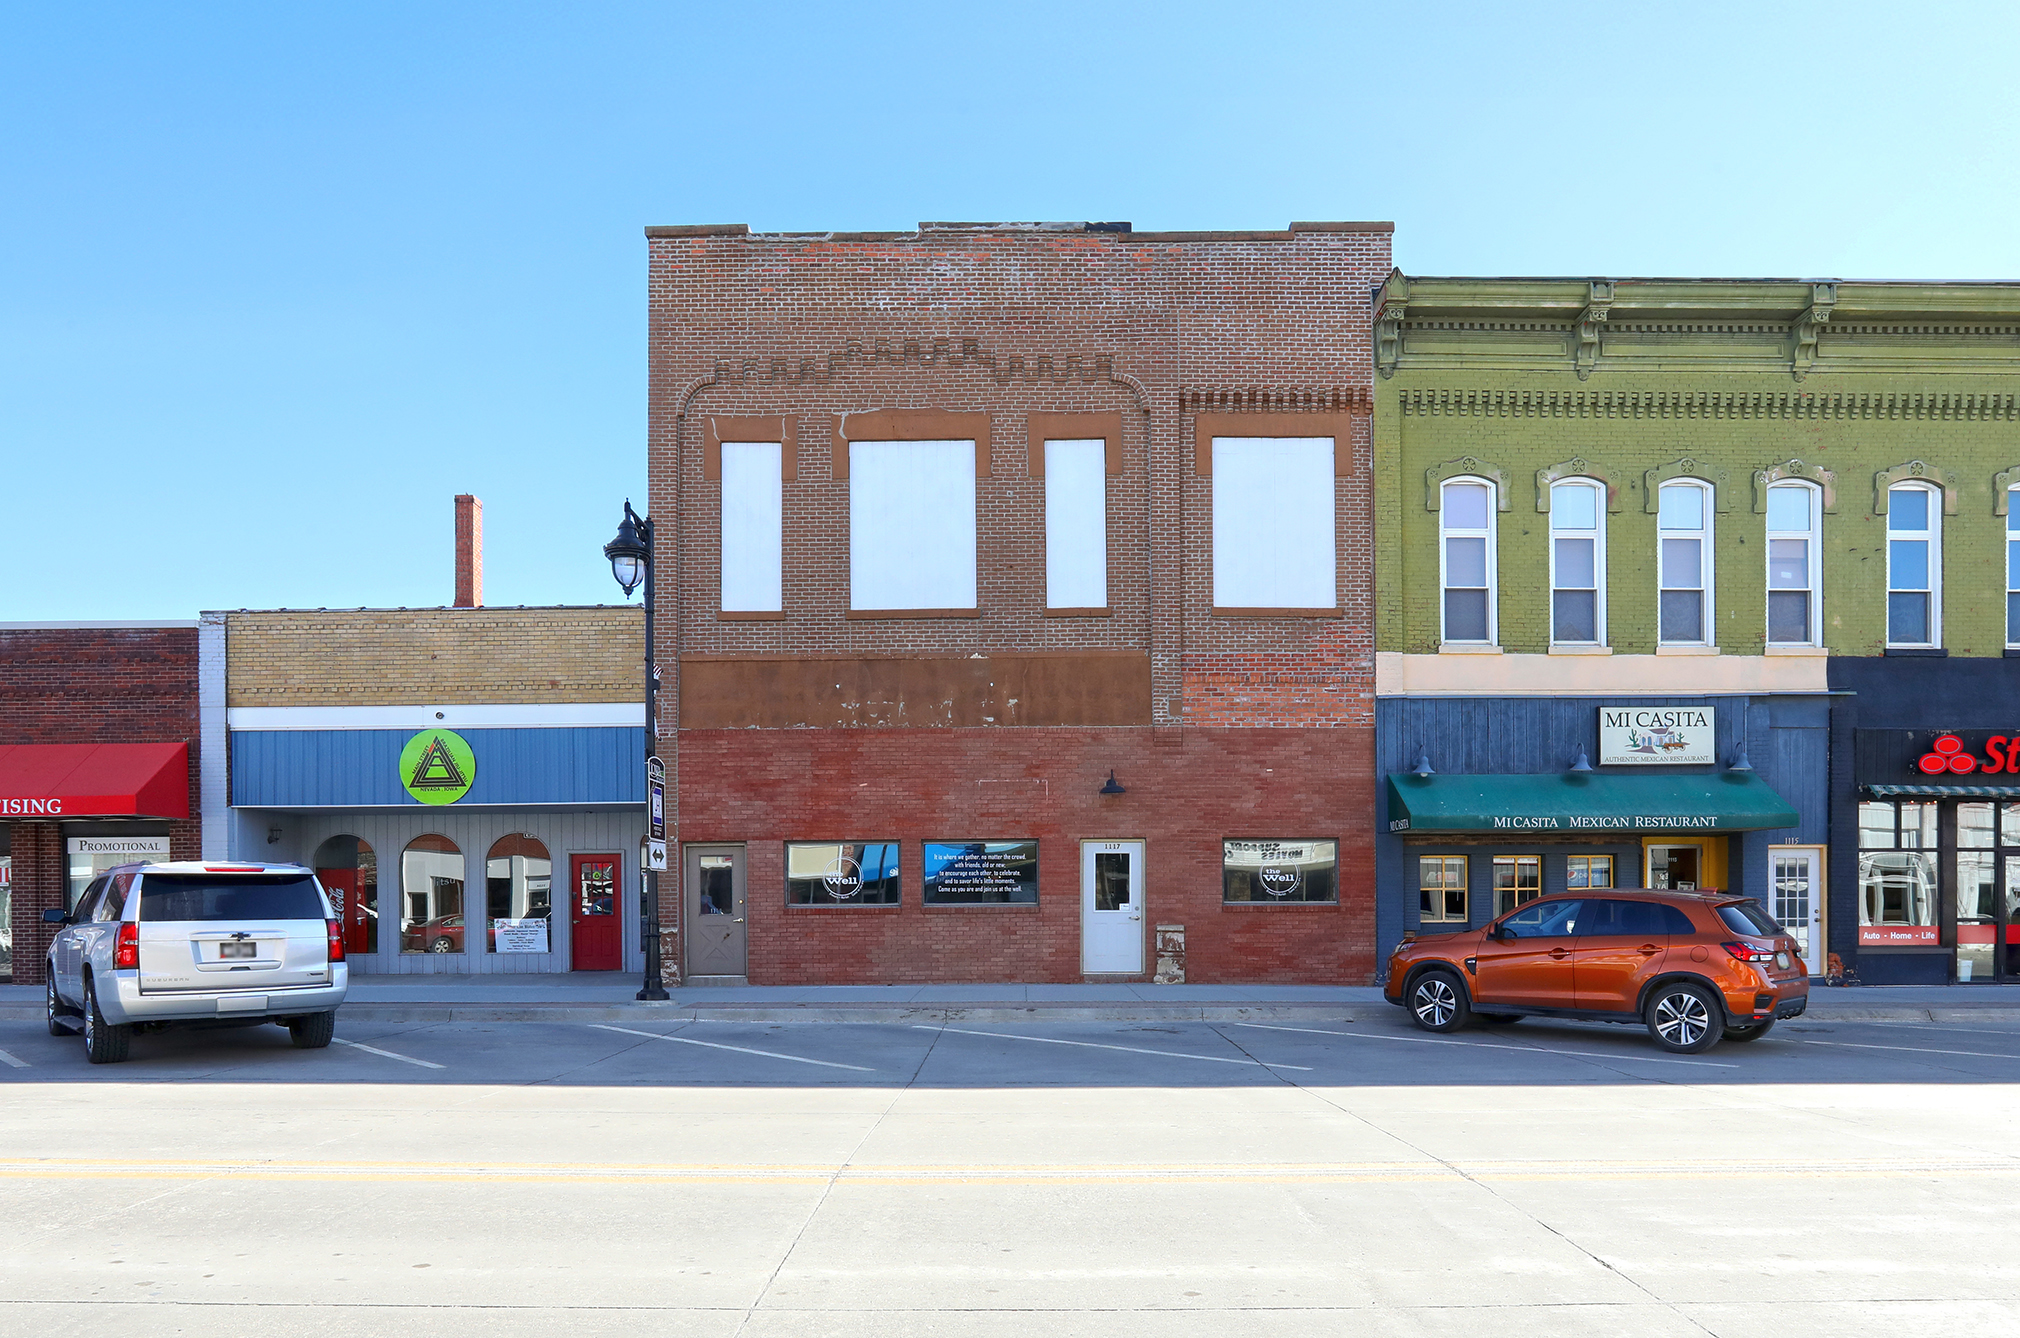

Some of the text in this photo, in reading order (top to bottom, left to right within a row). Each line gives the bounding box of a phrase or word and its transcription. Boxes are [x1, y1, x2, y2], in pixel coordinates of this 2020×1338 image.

[1605, 711, 1709, 728] MI CASITA
[418, 745, 430, 761] STREET
[1640, 755, 1670, 763] MEXICAN
[0, 798, 62, 814] ISING
[1493, 816, 1718, 828] MI CASITA MEXICAN RESTAURANT
[79, 840, 161, 851] PROMOTIONAL
[1784, 837, 1800, 845] 1115
[826, 877, 858, 885] Well
[1262, 874, 1295, 882] Well
[938, 885, 951, 893] Come
[983, 885, 992, 893] join
[1862, 931, 1937, 940] Auto Home Life
